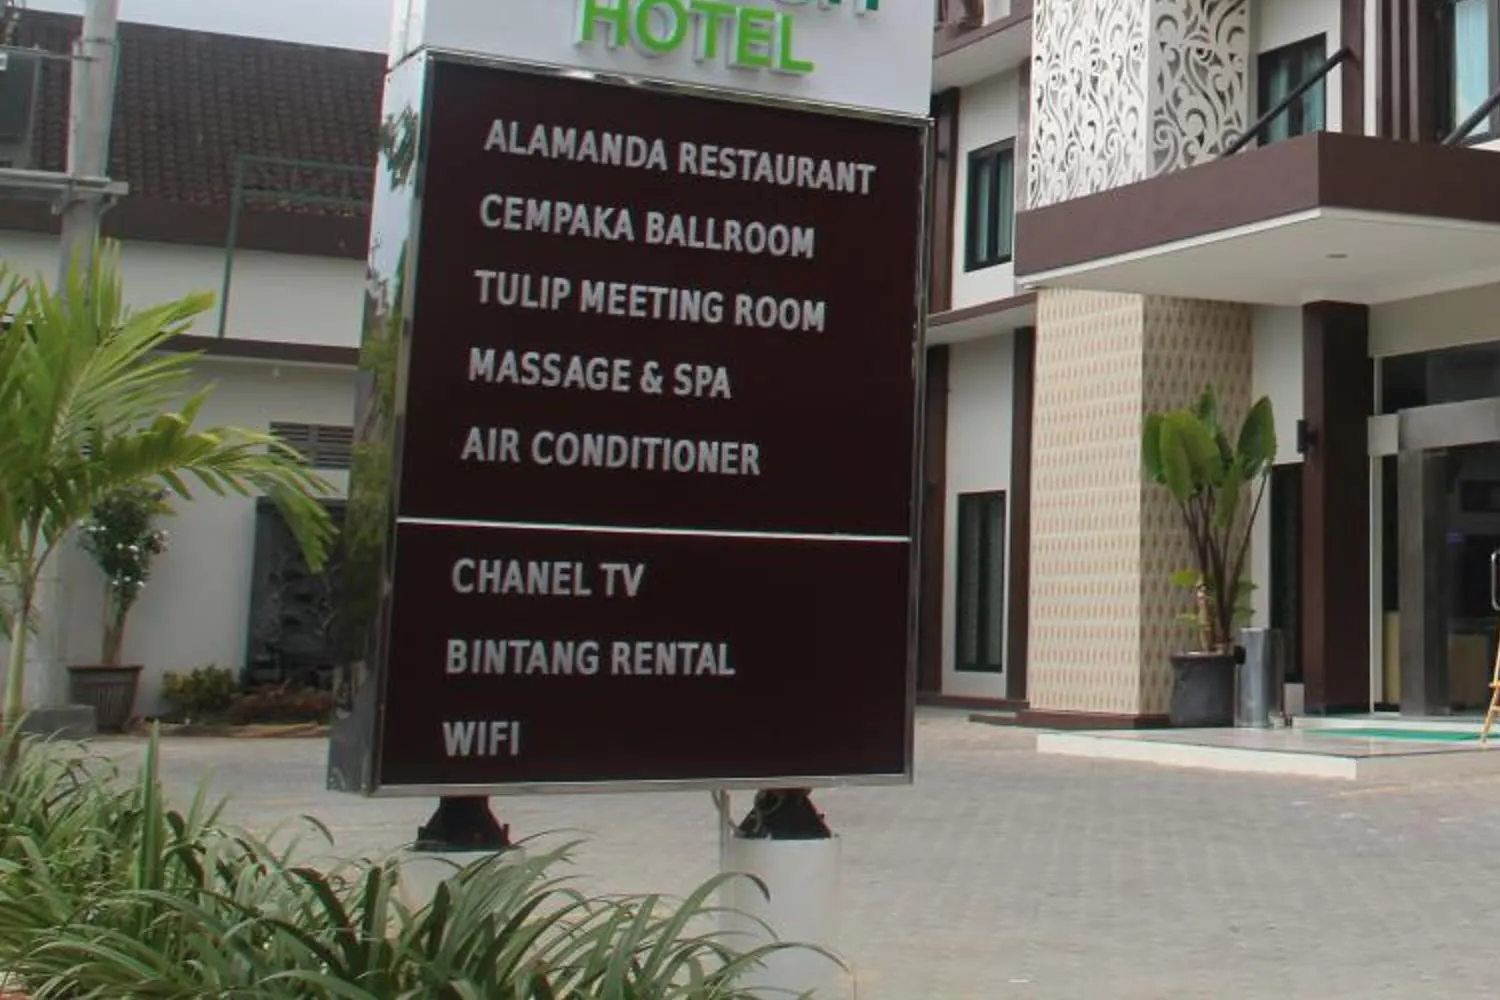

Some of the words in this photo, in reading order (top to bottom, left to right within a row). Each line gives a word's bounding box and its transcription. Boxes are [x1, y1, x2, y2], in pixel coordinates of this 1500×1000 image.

[484, 119, 668, 171] ALAMANDA
[678, 141, 877, 194] RESTAURANT
[480, 193, 635, 241] CEMPAKA
[645, 211, 815, 259] BALLROOM
[474, 269, 571, 310] TULIP
[580, 279, 724, 323] MEETING
[735, 293, 825, 332] ROOM
[469, 347, 631, 392] MASSAGE
[639, 360, 663, 394] &
[673, 363, 731, 399] SPA
[461, 426, 520, 462] AIR
[532, 431, 760, 475] CONDITIONER
[453, 558, 591, 595] CHANEL
[600, 563, 645, 597] TV
[447, 639, 599, 675] BINTANG
[611, 641, 735, 675] RENTAL
[443, 721, 519, 756] WIFI
